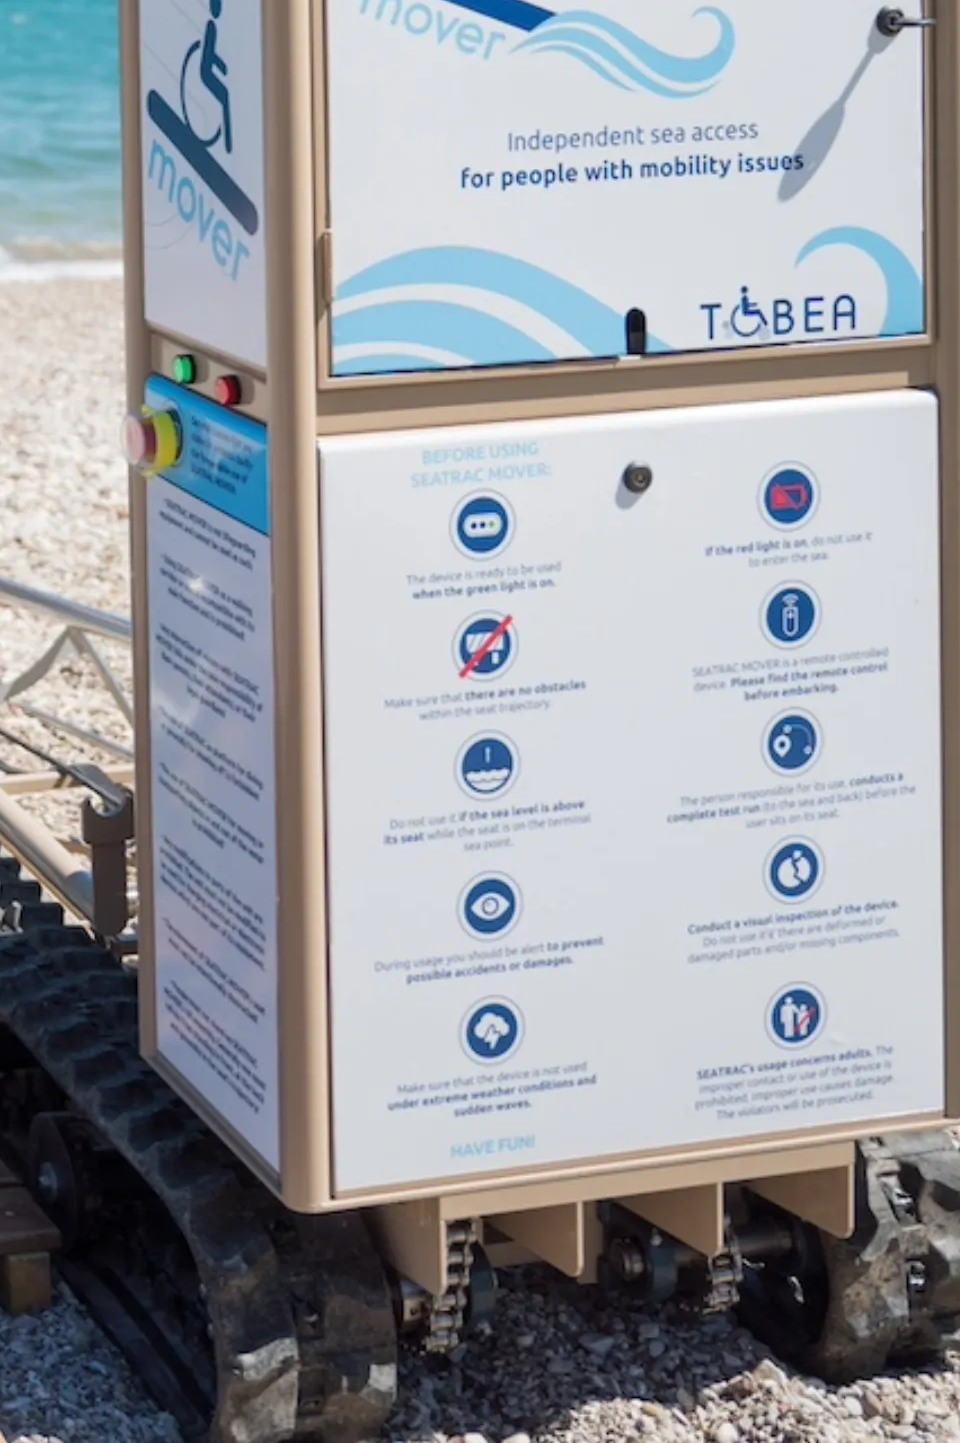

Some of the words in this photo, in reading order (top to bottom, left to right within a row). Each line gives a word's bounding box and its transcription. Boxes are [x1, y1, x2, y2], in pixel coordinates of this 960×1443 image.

[507, 126, 645, 153] Independent
[650, 129, 685, 144] sea
[691, 122, 759, 141] access
[460, 166, 495, 189] for
[501, 162, 579, 191] people
[585, 158, 633, 181] with
[640, 154, 732, 180] mobility
[737, 152, 805, 174] issues
[148, 139, 250, 281] mover
[421, 447, 486, 466] BEFORE
[488, 441, 539, 460] USING
[486, 463, 551, 481] MOVER:
[704, 545, 714, 557] If
[714, 544, 734, 556] the
[734, 542, 754, 554] red
[754, 539, 781, 554] light
[781, 539, 792, 550] is
[747, 556, 761, 569] to
[790, 552, 809, 563] the
[463, 569, 474, 581] is
[505, 565, 519, 577] to
[411, 588, 443, 600] when
[443, 585, 464, 597] the
[465, 583, 498, 597] green
[499, 579, 526, 594] light
[526, 579, 538, 589] is
[781, 658, 790, 668] is
[791, 658, 799, 668] a
[799, 653, 837, 666] remote
[729, 676, 766, 687] Please
[766, 671, 789, 684] find
[790, 670, 808, 682] the
[810, 667, 849, 679] remote
[849, 661, 888, 676] control
[464, 689, 495, 702] there
[497, 687, 516, 698] are
[517, 685, 533, 696] no
[533, 679, 586, 694] obstacles
[743, 688, 780, 702] before
[812, 780, 826, 792] its
[848, 772, 896, 787] conducts
[896, 772, 904, 782] a
[458, 810, 467, 822] if
[468, 809, 488, 822] the
[490, 808, 510, 819] sea
[511, 803, 539, 816] level
[540, 803, 550, 813] is
[551, 800, 585, 813] above
[666, 809, 717, 823] complete
[717, 805, 741, 818] test
[741, 803, 761, 814] run
[383, 834, 399, 845] its
[399, 831, 425, 844] seat
[456, 825, 476, 838] the
[476, 822, 500, 836] seat
[501, 822, 511, 833] is
[526, 818, 546, 830] the
[463, 841, 482, 852] sea
[686, 919, 732, 935] Conduct
[733, 920, 741, 929] a
[741, 914, 775, 927] visual
[774, 908, 829, 923] inspection
[830, 904, 843, 917] of
[843, 903, 862, 915] the
[412, 955, 445, 969] usage
[545, 941, 560, 952] to
[560, 936, 604, 952] prevent
[405, 968, 453, 985] possible
[454, 962, 507, 978] accidents
[508, 961, 521, 972] or
[475, 1074, 495, 1085] the
[531, 1068, 541, 1078] is
[696, 1063, 755, 1081] SEATRAC's
[756, 1059, 788, 1073] usage
[788, 1053, 837, 1068] concerns
[387, 1098, 420, 1112] under
[421, 1092, 469, 1107] extreme
[470, 1086, 515, 1100] weather
[517, 1078, 575, 1095] conditions
[576, 1073, 597, 1087] and
[453, 1103, 494, 1118] sudden
[449, 1139, 495, 1158] HAVE
[496, 1135, 536, 1153] FUN!
